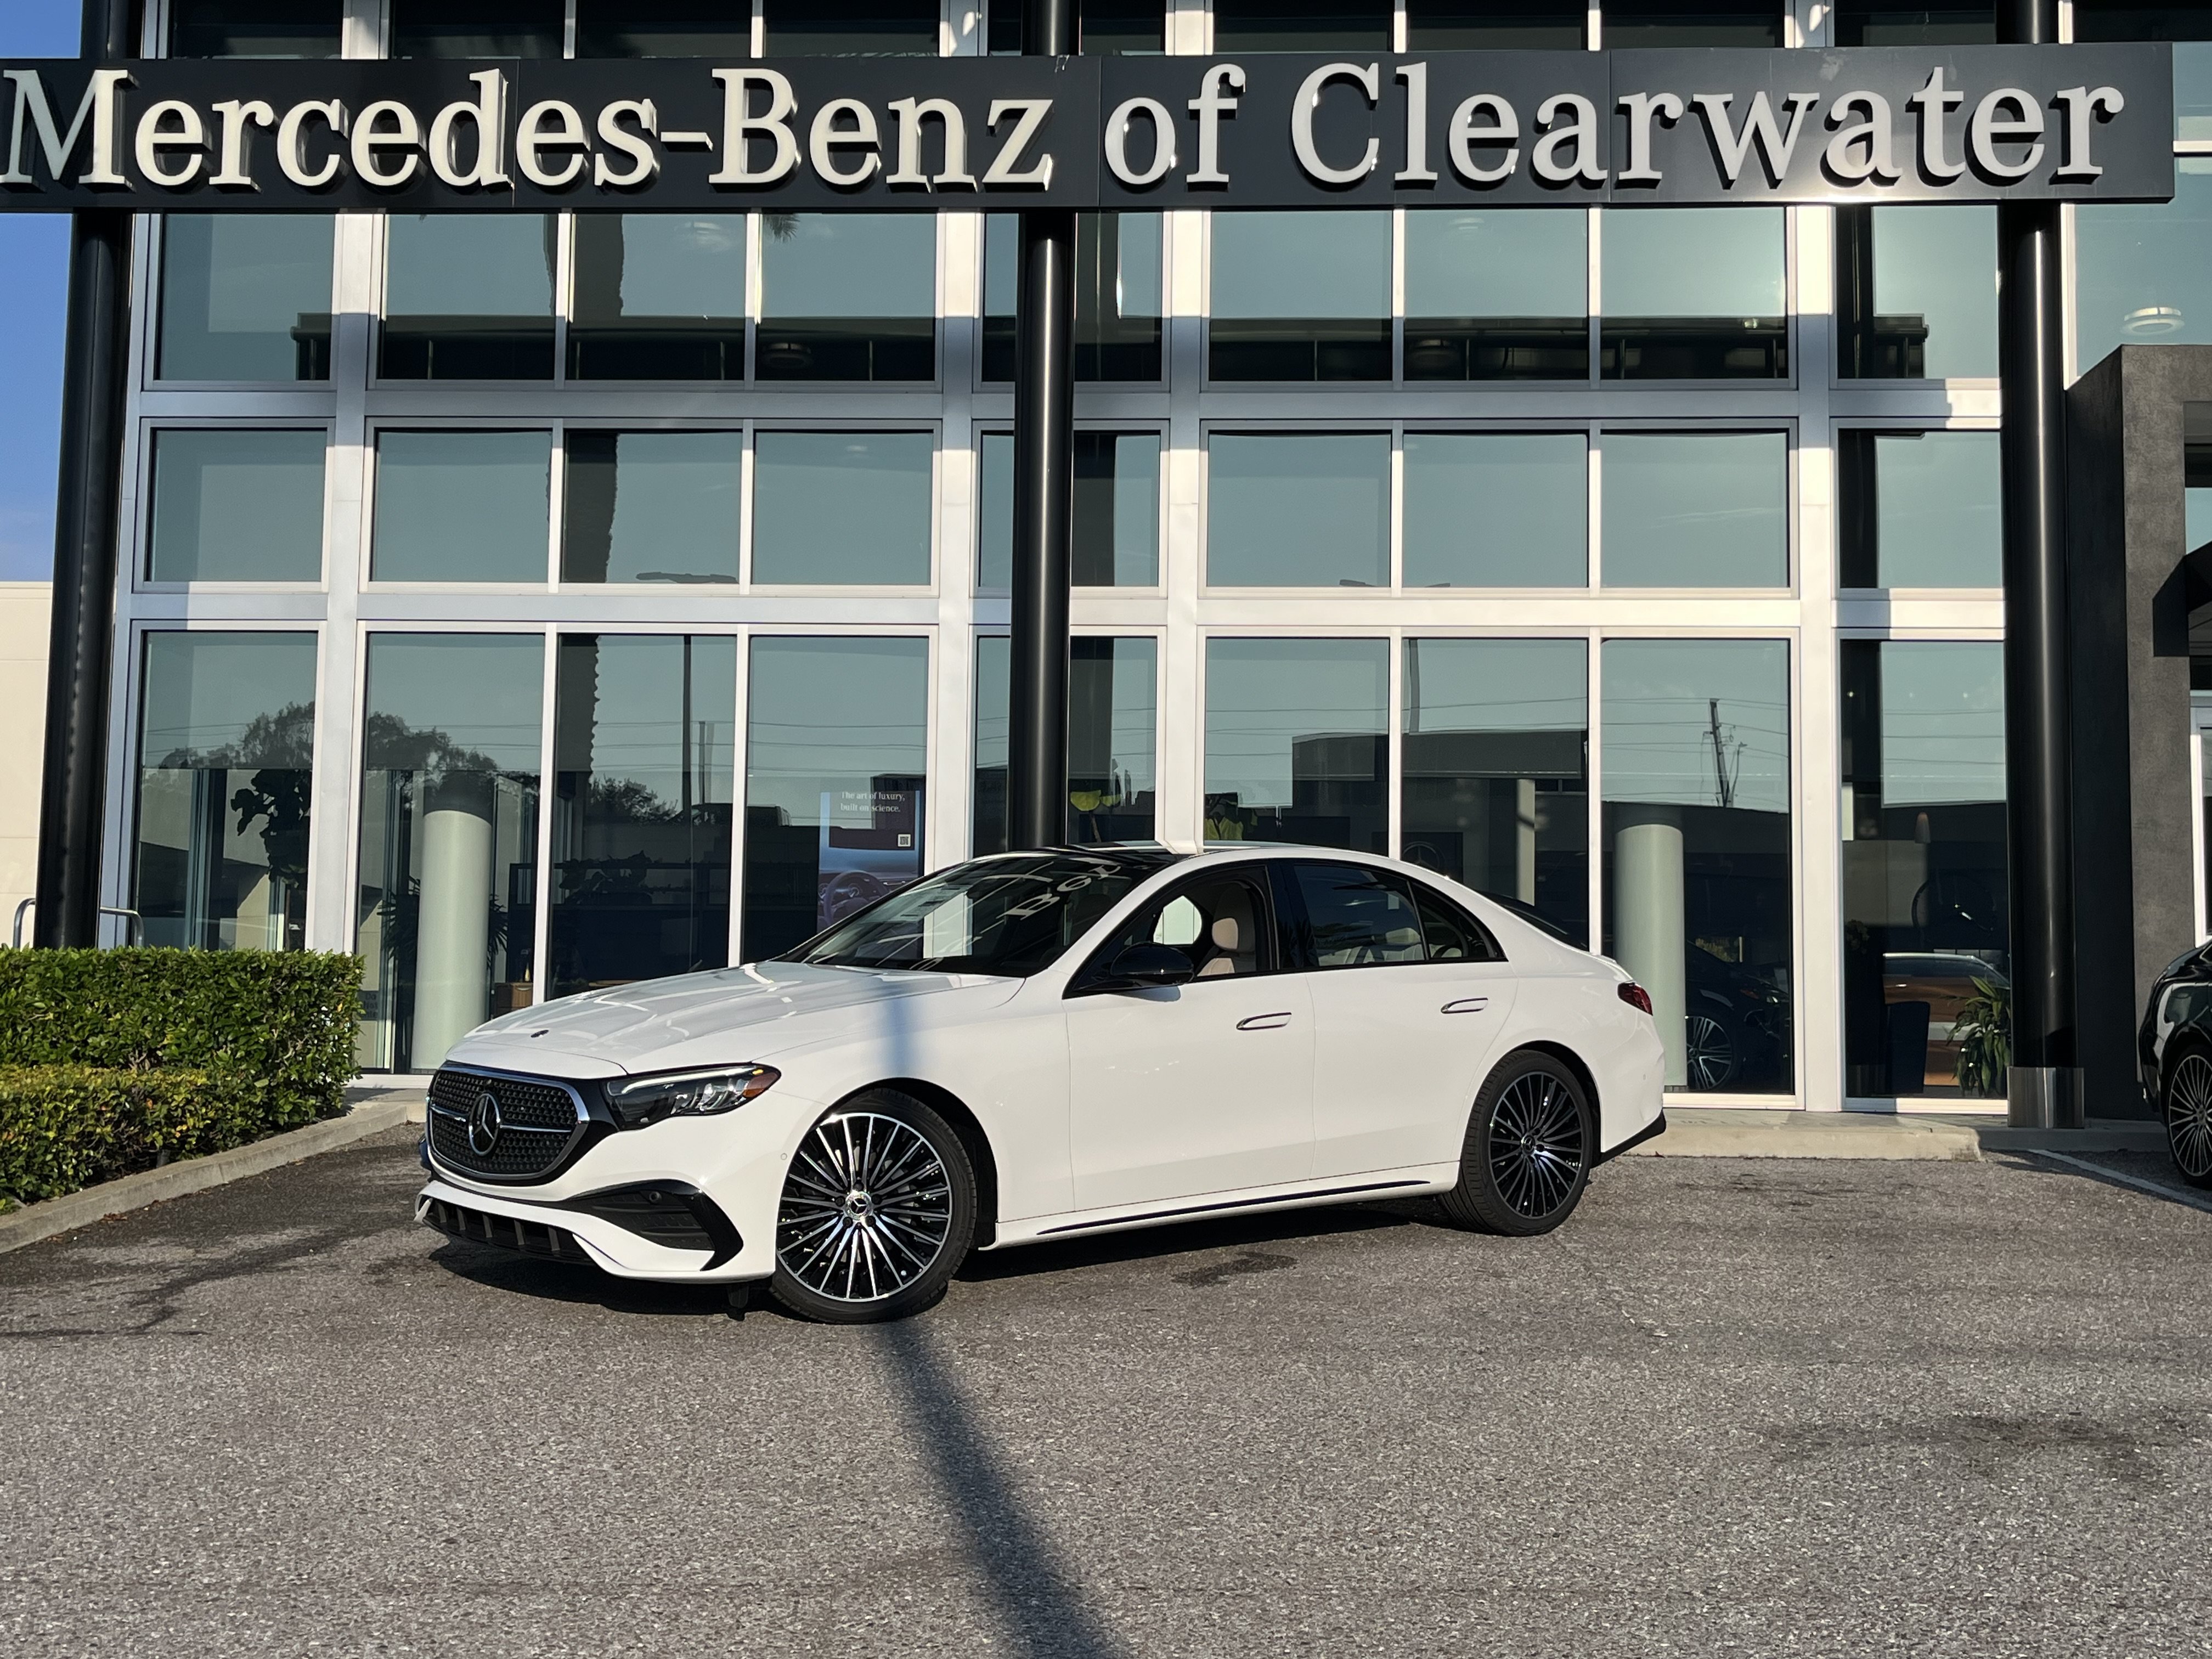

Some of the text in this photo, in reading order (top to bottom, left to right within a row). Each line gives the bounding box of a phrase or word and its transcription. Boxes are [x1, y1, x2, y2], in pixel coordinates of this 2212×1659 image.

[2, 60, 2125, 189] Mercedes-Benz of Clearwater
[842, 791, 855, 799] The
[869, 791, 877, 799] of
[878, 792, 906, 802] luxury,
[840, 803, 857, 811] built
[871, 803, 900, 812] science.
